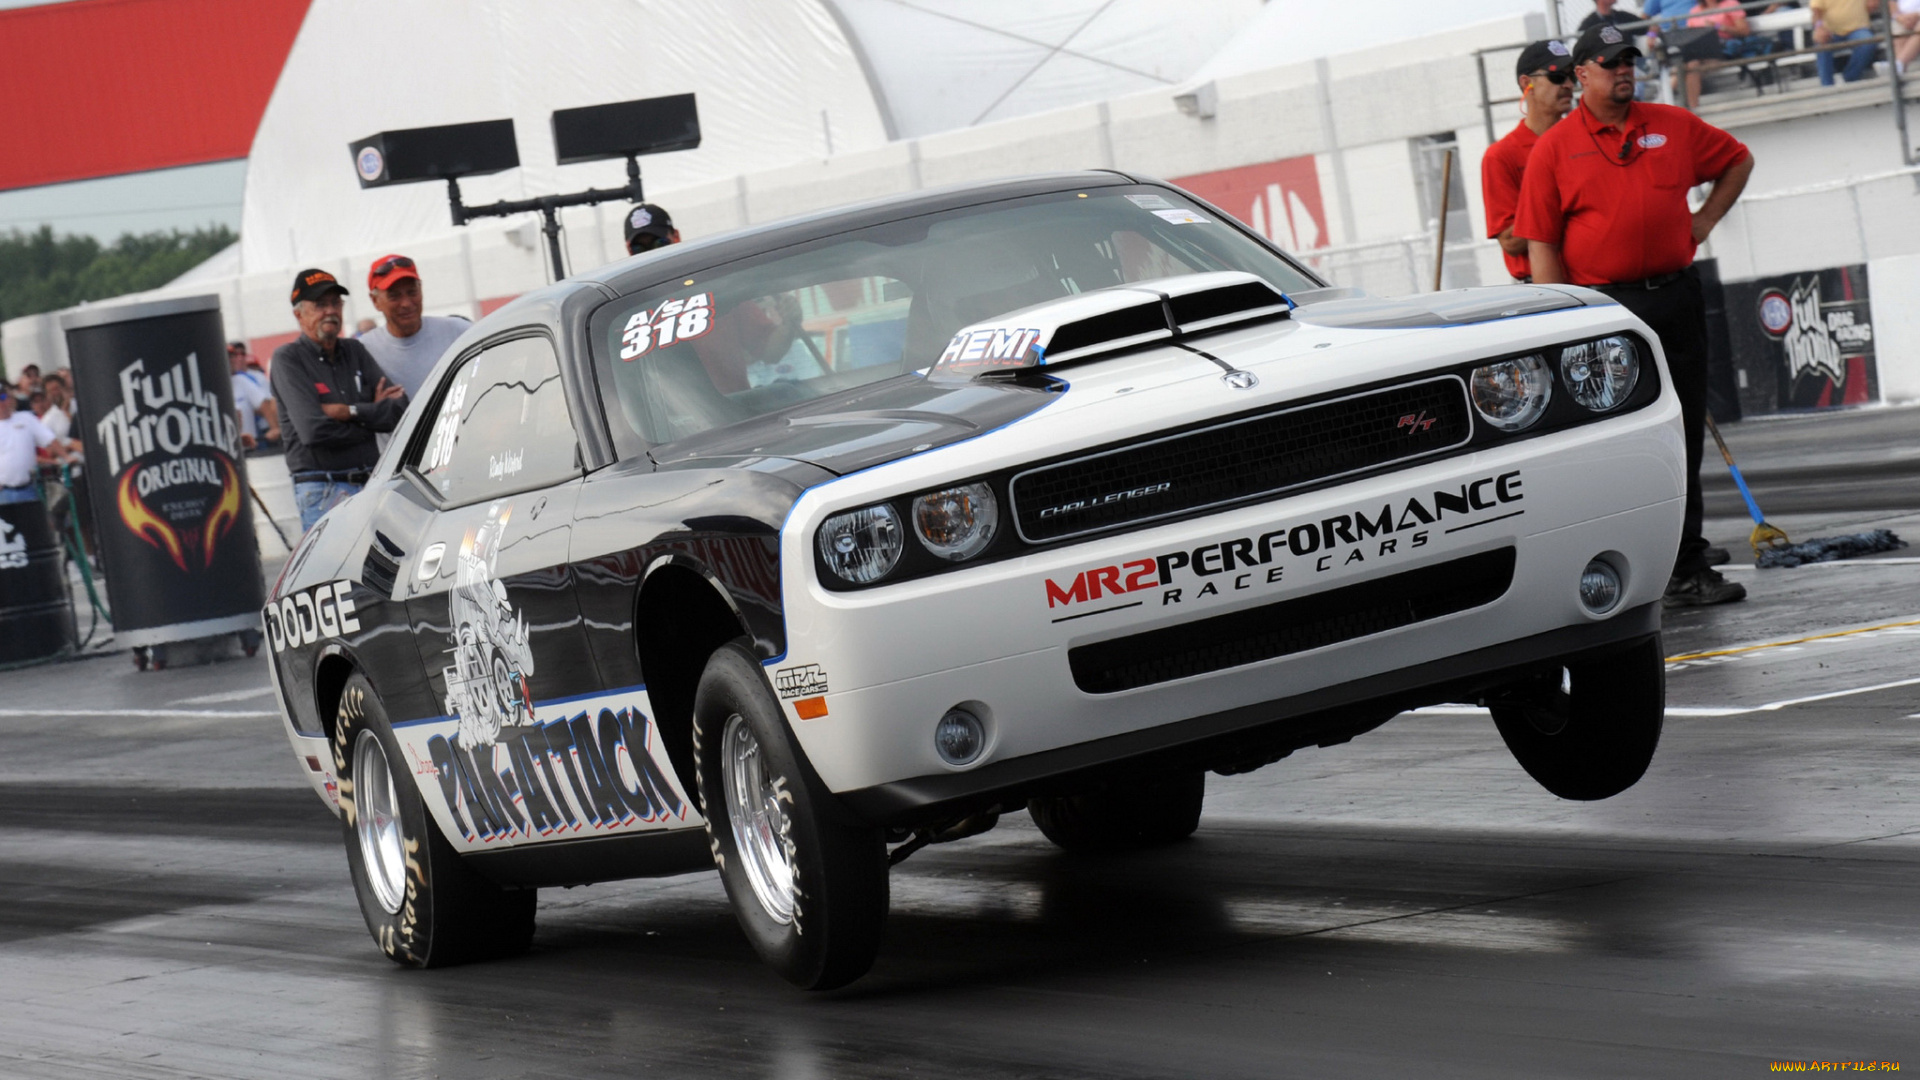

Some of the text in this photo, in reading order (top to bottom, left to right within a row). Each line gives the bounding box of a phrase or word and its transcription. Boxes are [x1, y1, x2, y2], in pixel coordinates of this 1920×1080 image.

[620, 307, 715, 361] 318
[623, 292, 713, 332] A/SA
[937, 328, 1040, 368] HEMI
[119, 352, 209, 424] Full
[430, 413, 460, 468] 318
[1397, 411, 1436, 434] R/T
[137, 457, 222, 498] ORIGINAL
[1040, 482, 1171, 519] CHALLENGER
[1162, 530, 1429, 606] RACE CARS
[267, 579, 361, 653] DODGE
[781, 689, 800, 698] RACE
[427, 705, 687, 843] PAK-ATTACK
